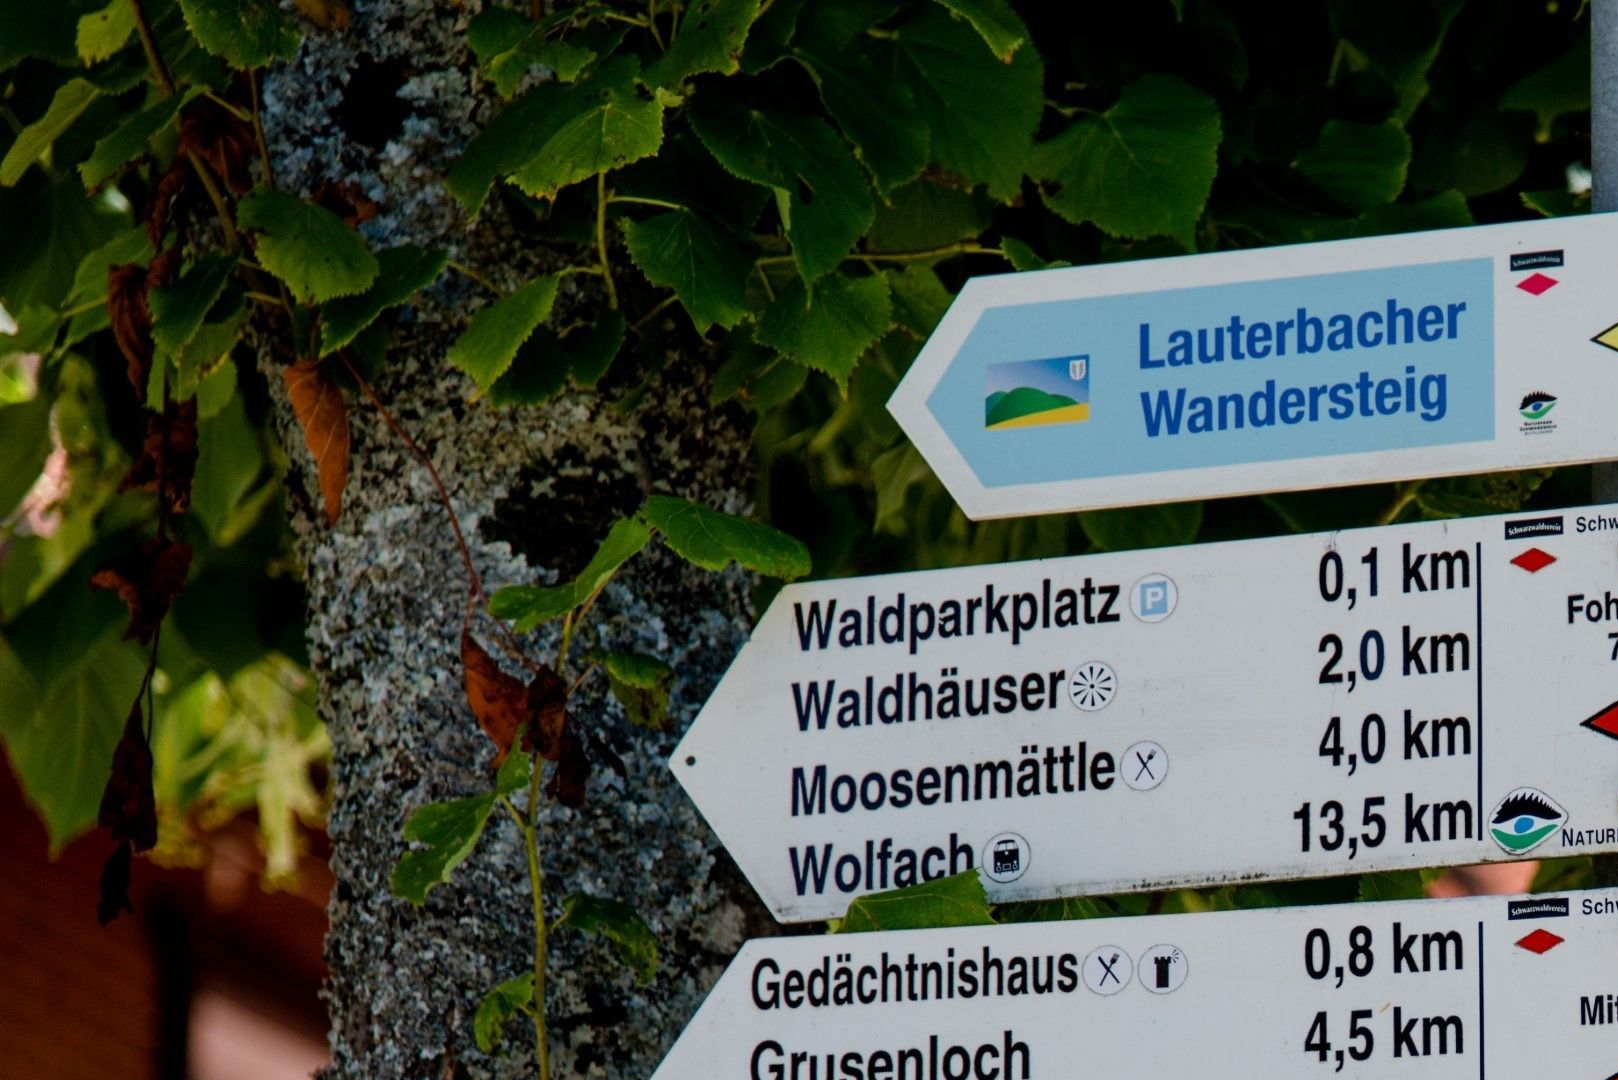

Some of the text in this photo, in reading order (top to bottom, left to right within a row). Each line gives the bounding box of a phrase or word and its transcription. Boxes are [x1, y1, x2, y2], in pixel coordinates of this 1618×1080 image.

[1140, 299, 1466, 369] Lauterbacher
[1140, 365, 1446, 437] Wandersteig
[1508, 522, 1561, 536] Schwarzwaldverein
[1319, 543, 1470, 610] 0,1 km
[795, 578, 1120, 655] Waldparkplatz
[1319, 625, 1470, 693] 2,0 km
[792, 667, 1065, 731] Waldhäuser
[1319, 710, 1471, 776] 4,0 km
[790, 742, 1116, 816] Moosenmättle
[1294, 793, 1472, 860] 13,5 km
[789, 833, 974, 896] Wolfach
[1511, 904, 1567, 916] Schwarzwaldverein
[751, 946, 1078, 1011] Gedächtnishaus
[1305, 922, 1463, 988] 0,8 km
[1305, 1006, 1463, 1072] 4,5 km
